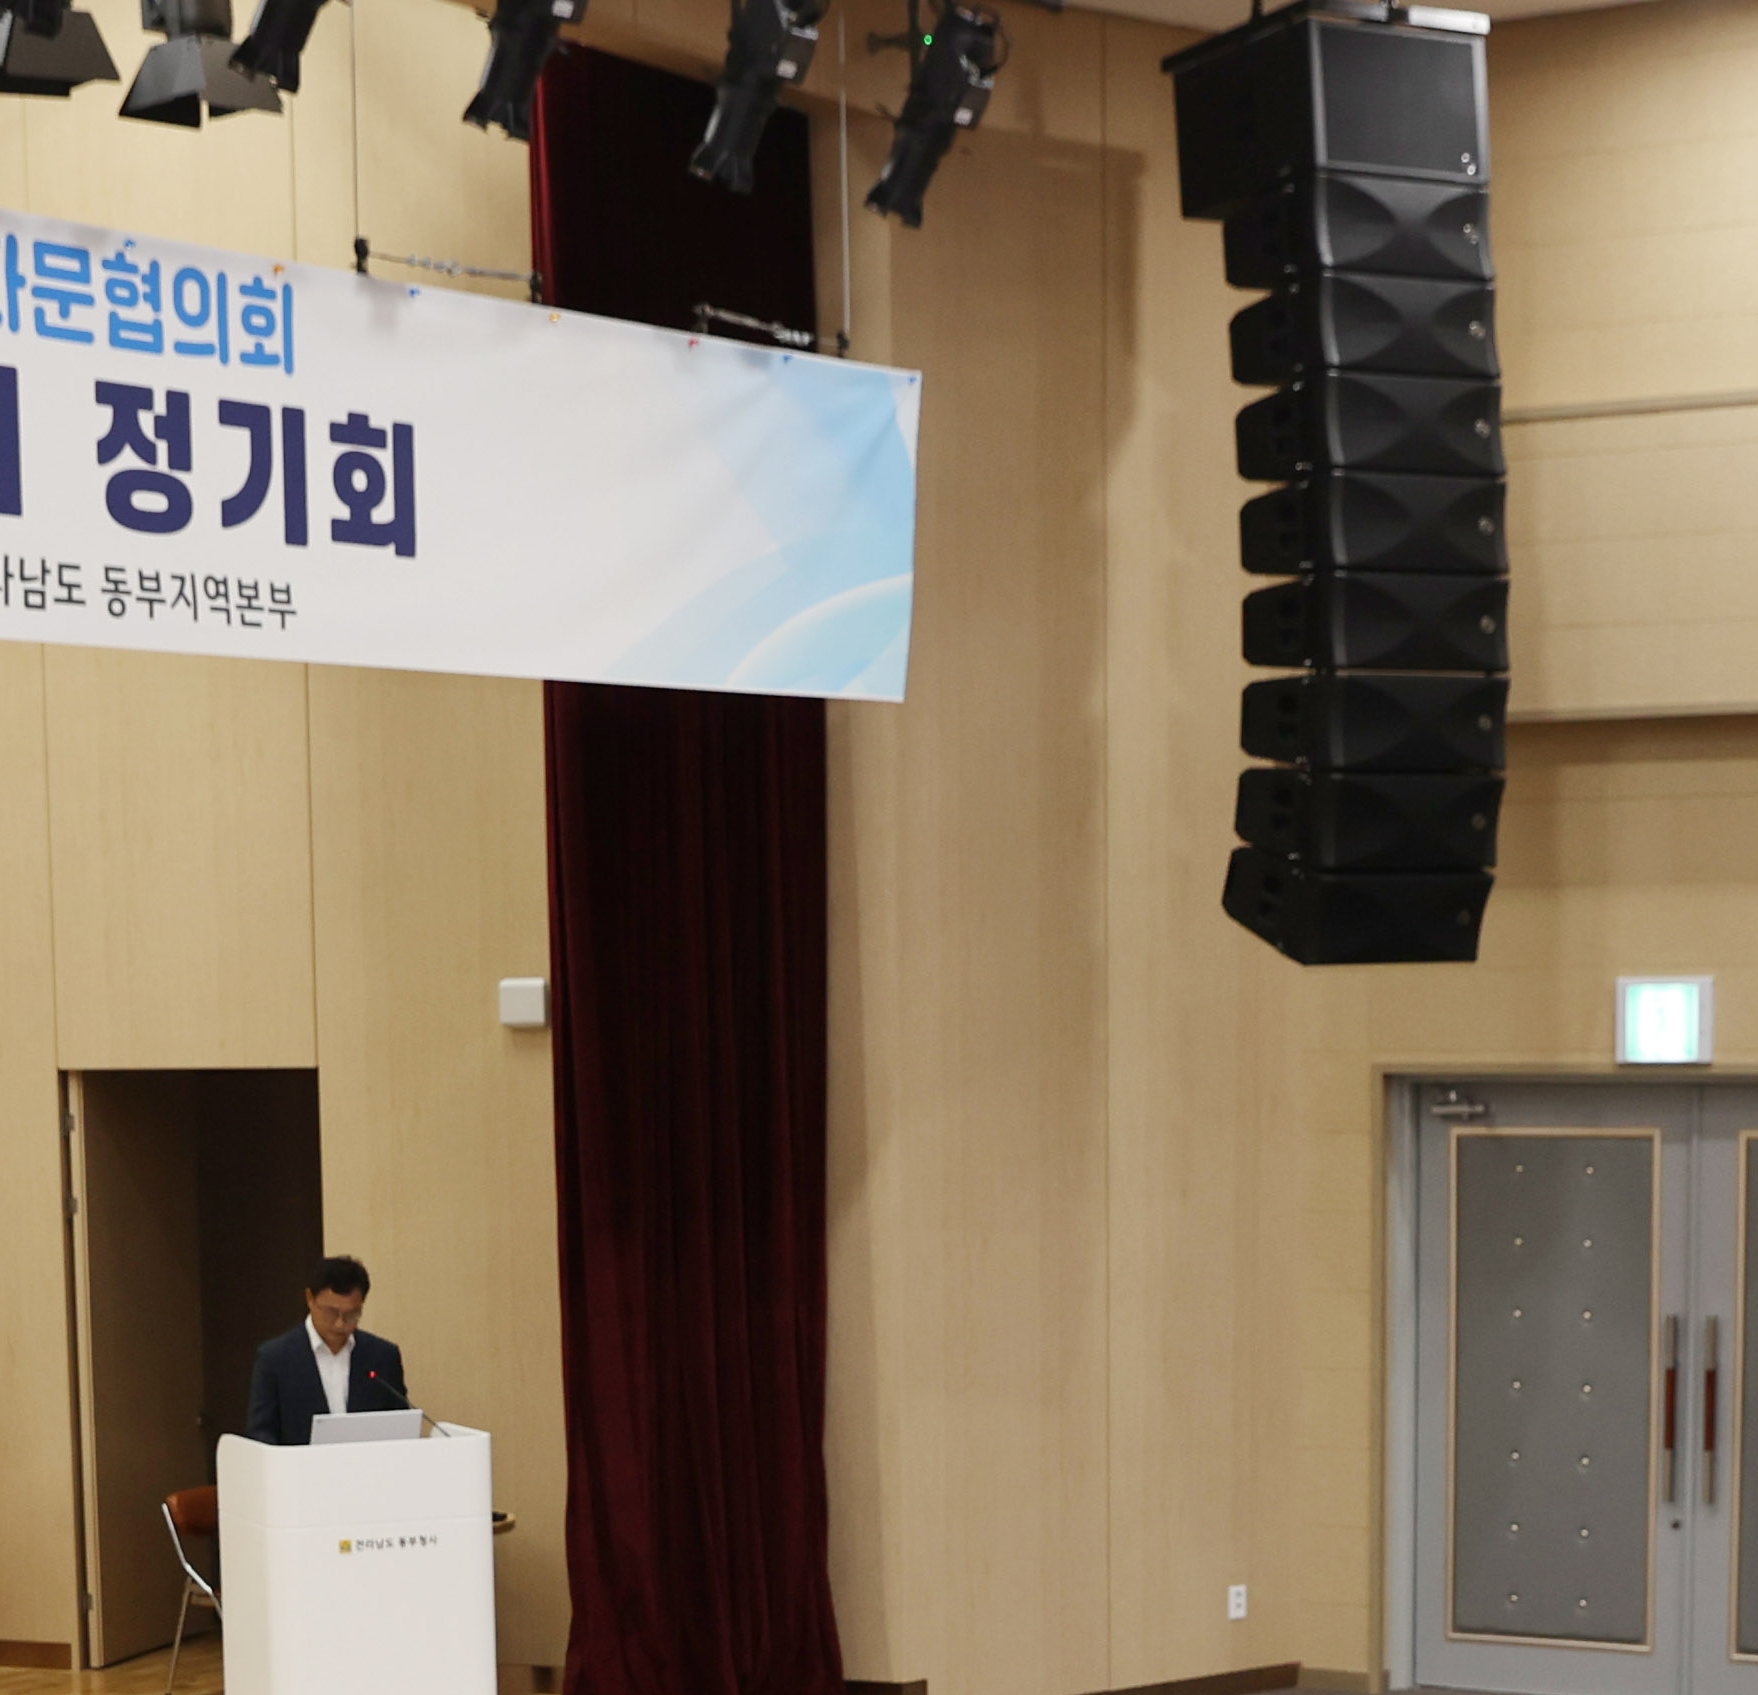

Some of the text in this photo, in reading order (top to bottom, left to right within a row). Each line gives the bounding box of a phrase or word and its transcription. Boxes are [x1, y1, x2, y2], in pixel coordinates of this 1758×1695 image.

[94, 380, 416, 557] 정기회
[101, 565, 297, 630] 동부지역본부
[355, 1538, 394, 1552] 전라남도
